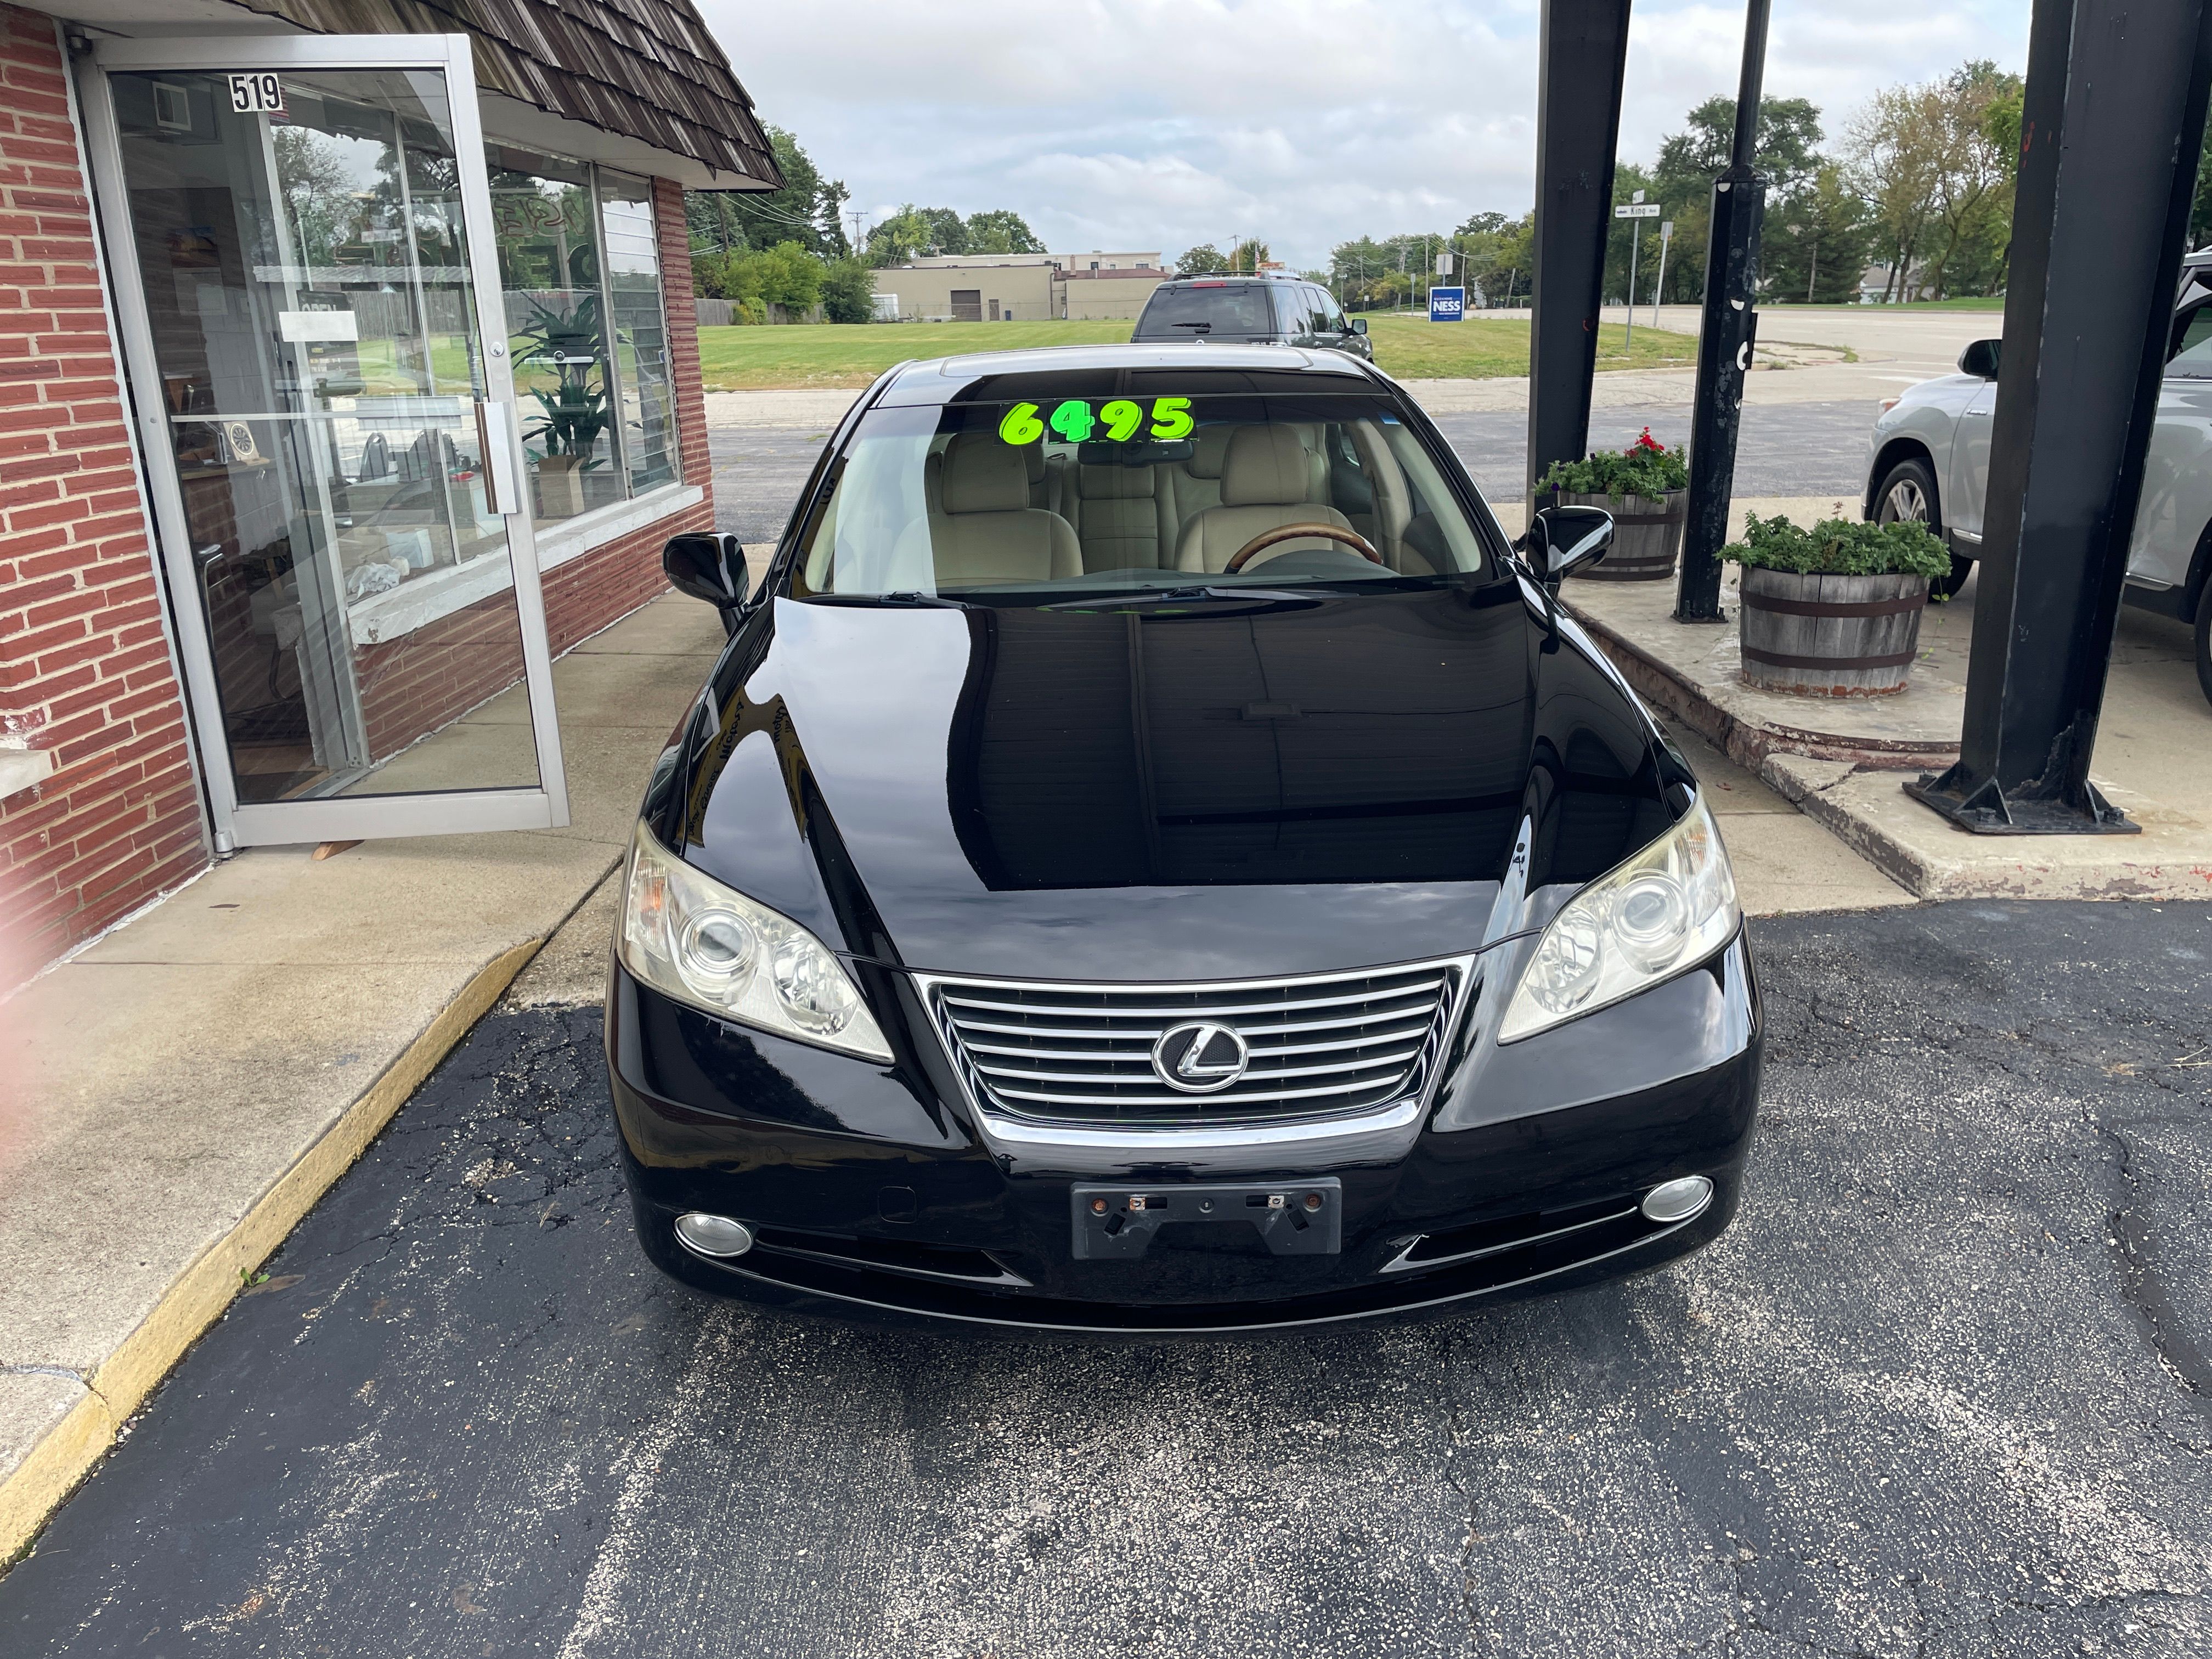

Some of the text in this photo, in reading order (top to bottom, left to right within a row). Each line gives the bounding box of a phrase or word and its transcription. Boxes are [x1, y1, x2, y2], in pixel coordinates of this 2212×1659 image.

[232, 75, 280, 110] 519
[1630, 207, 1646, 217] King
[1433, 300, 1461, 312] NESS
[999, 398, 1194, 444] 6495
